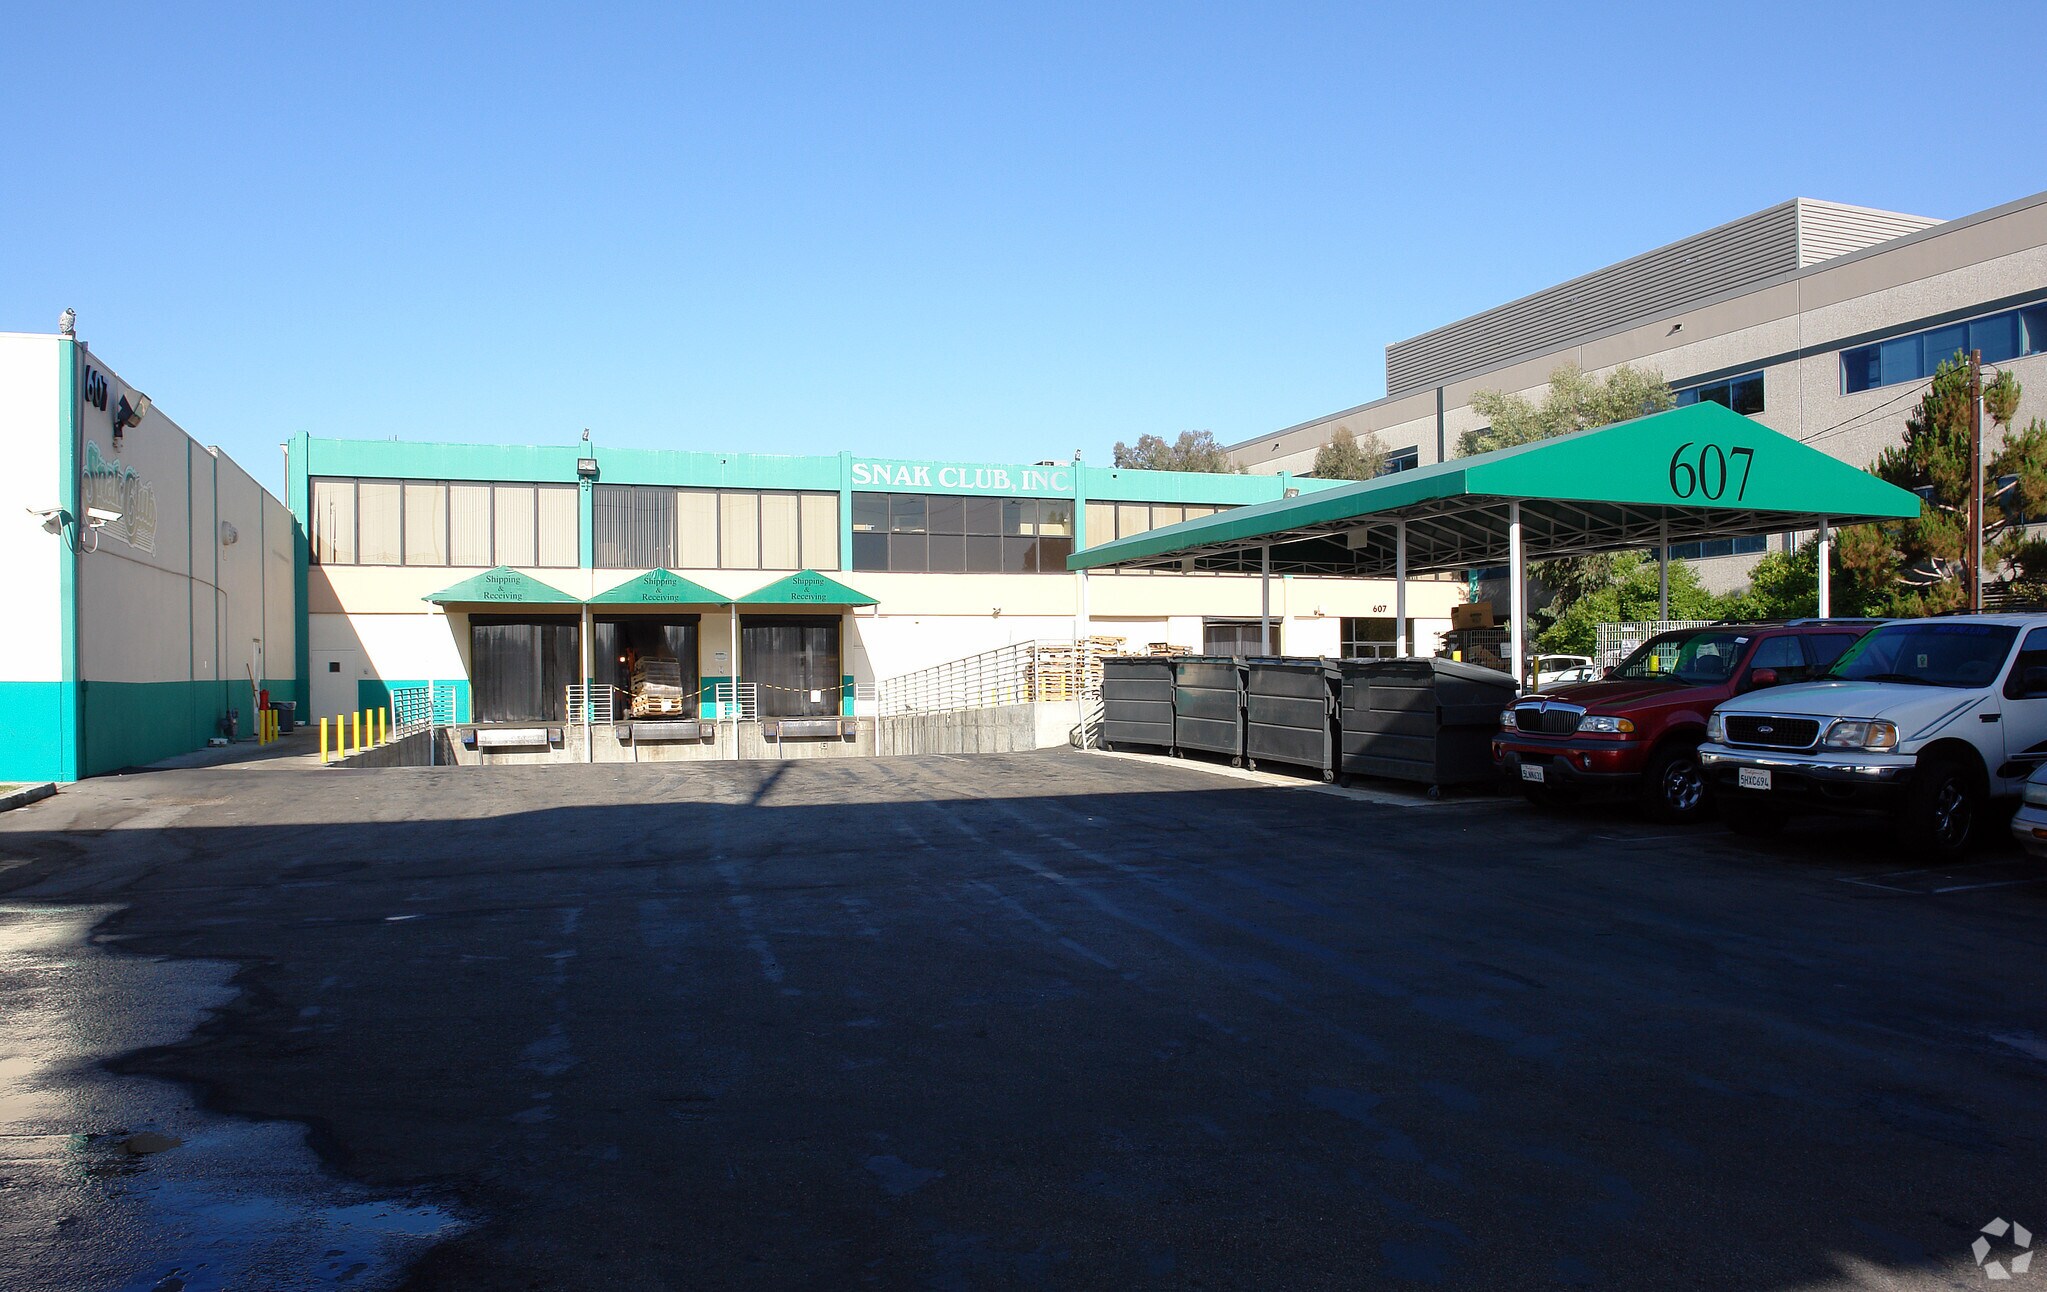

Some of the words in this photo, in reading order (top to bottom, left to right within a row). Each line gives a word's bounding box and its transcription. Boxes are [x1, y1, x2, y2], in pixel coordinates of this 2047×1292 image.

[84, 364, 107, 412] 607
[1669, 441, 1755, 502] 607
[851, 463, 933, 487] SNAK
[938, 467, 1017, 493] CLUB,
[1021, 470, 1074, 492] INC.
[485, 575, 521, 585] Shipping
[643, 577, 678, 587] Shipping
[792, 577, 825, 586] Shipping
[483, 591, 523, 602] Receiving
[642, 593, 680, 603] Receiving
[791, 592, 827, 602] Receiving
[1372, 604, 1387, 613] 607
[1740, 774, 1769, 787] 5HXC694
